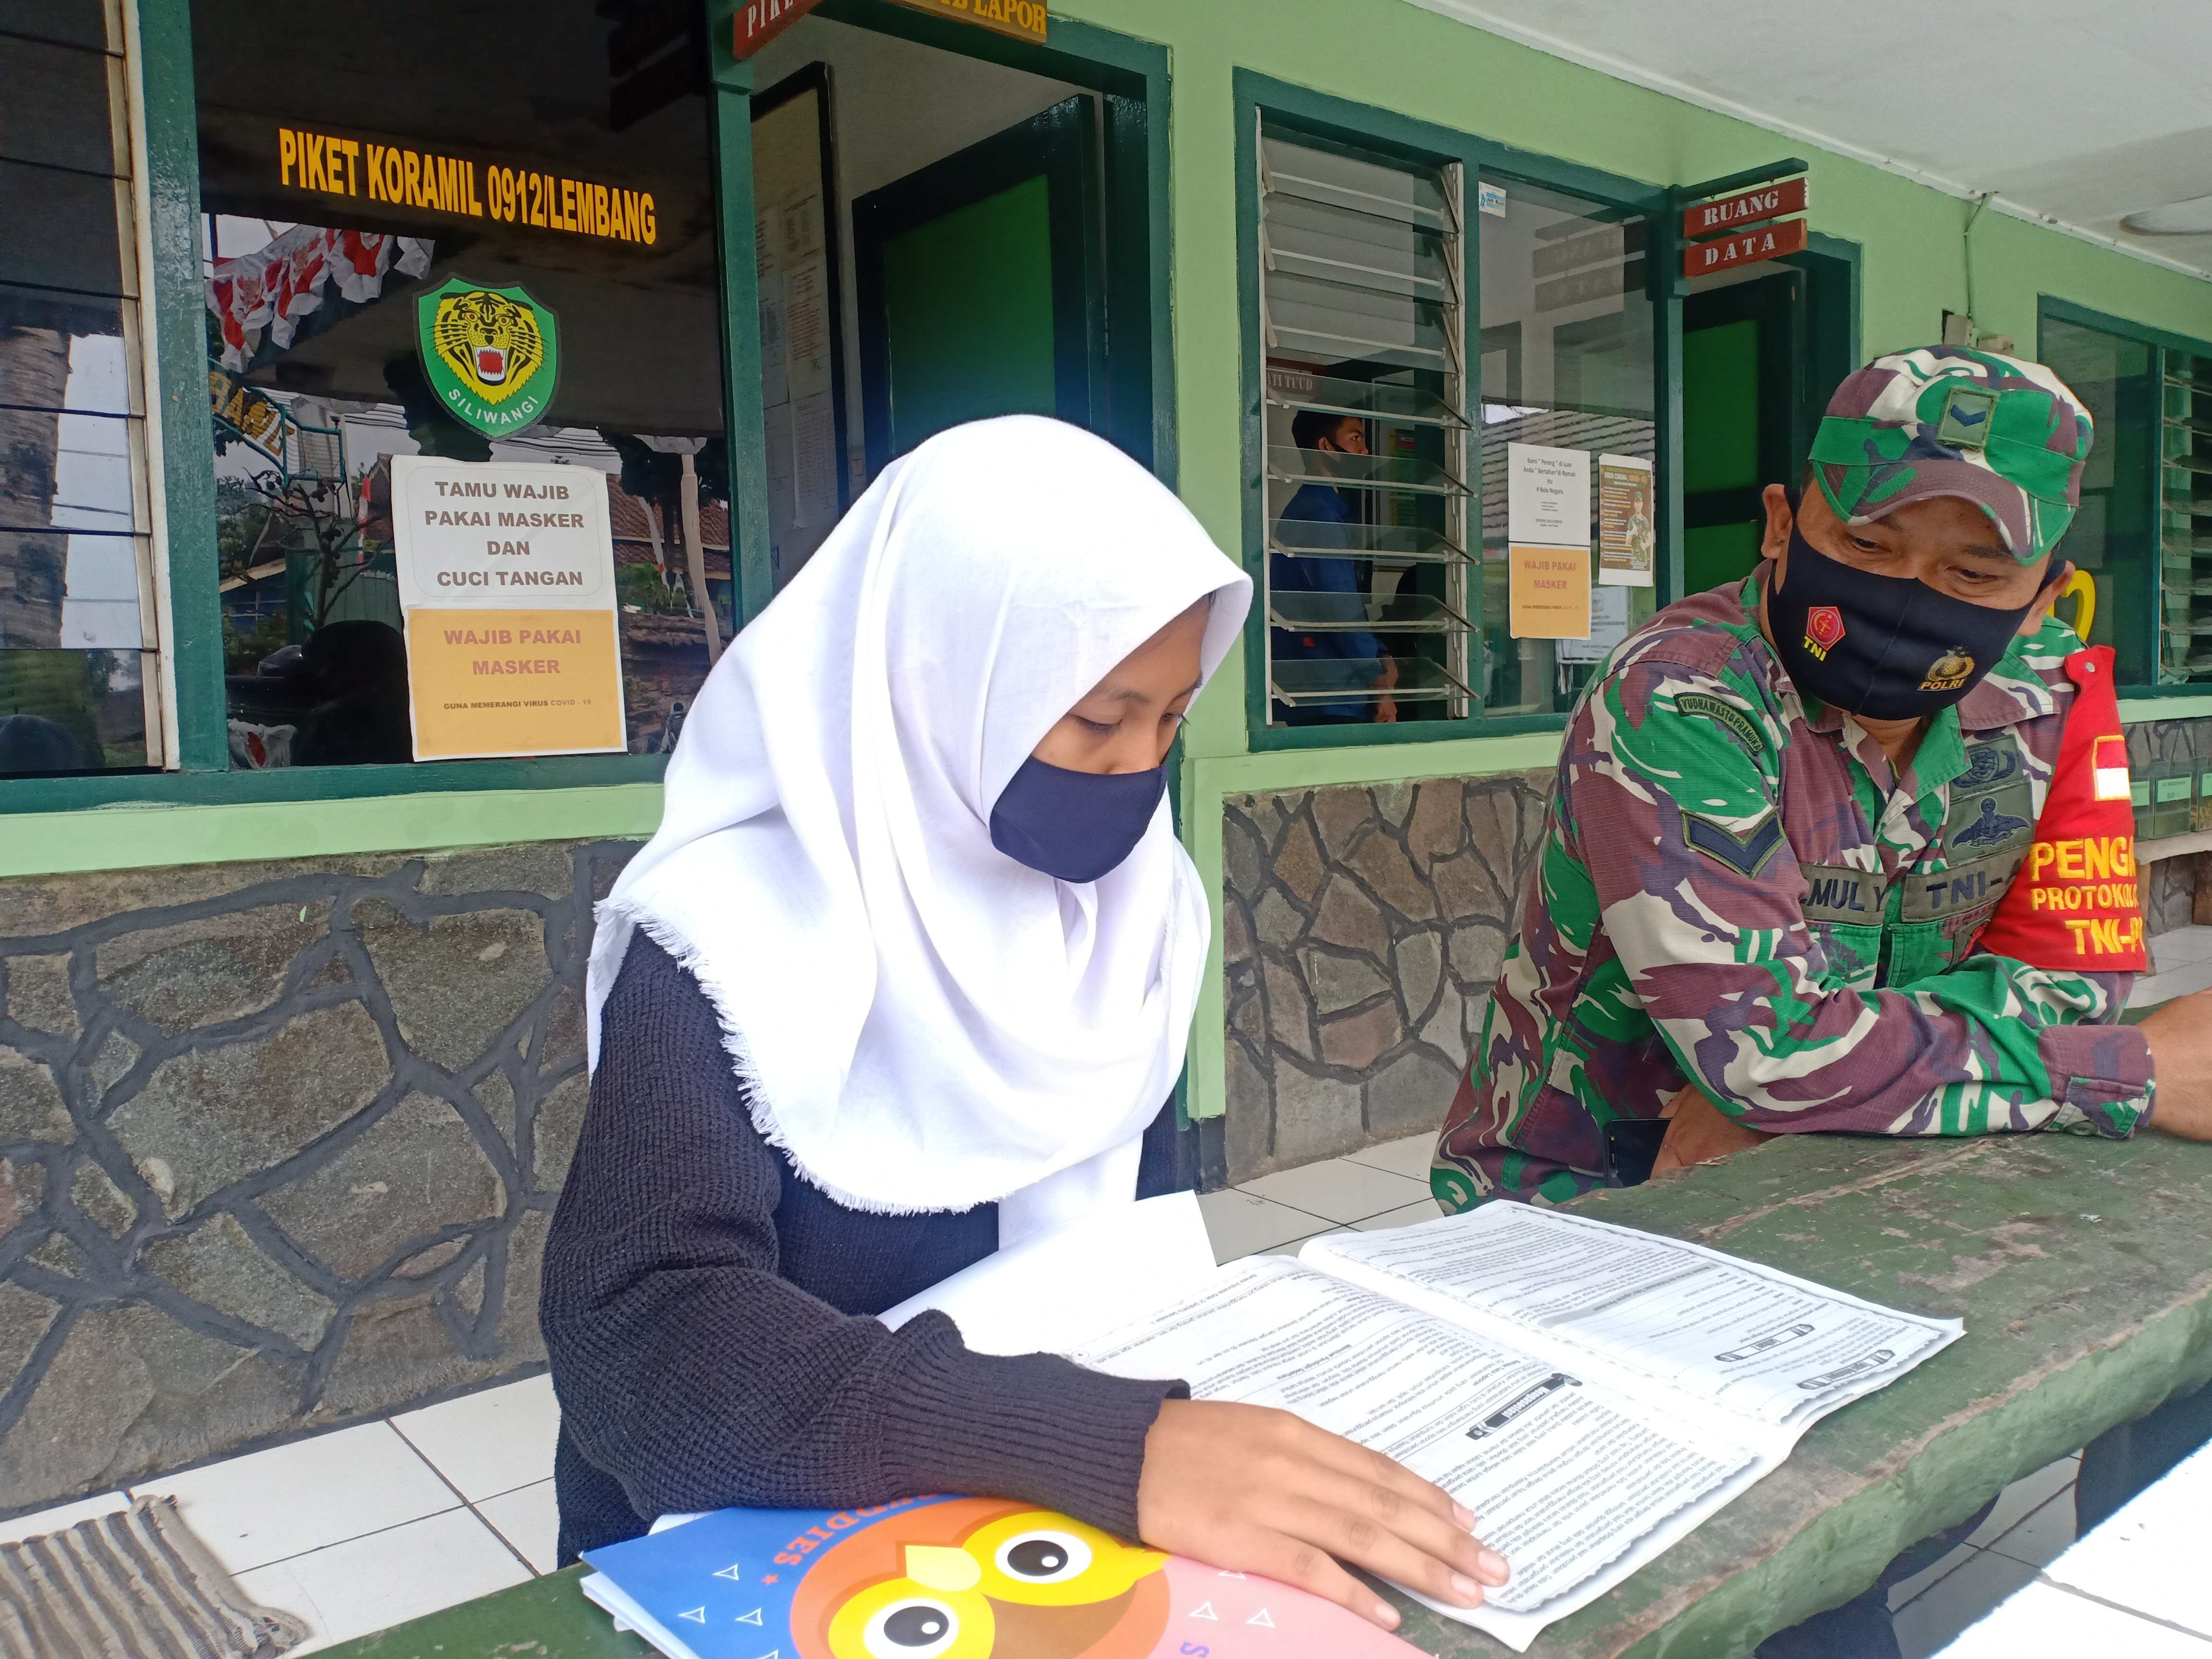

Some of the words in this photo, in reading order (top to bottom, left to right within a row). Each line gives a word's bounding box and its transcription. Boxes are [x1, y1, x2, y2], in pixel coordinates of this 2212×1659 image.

[279, 128, 359, 196] PIKET
[366, 144, 481, 216] KORAMIL
[487, 165, 656, 245] 0912/LEMBANG
[1704, 190, 1779, 226] RUANG
[1705, 233, 1776, 265] DATA
[449, 388, 539, 424] SILIWANGI
[1541, 459, 1555, 467] Perang
[435, 481, 497, 498] TAMU
[503, 483, 570, 500] WAJIB
[424, 510, 490, 527] PAKAI
[498, 512, 585, 528] MASKER
[487, 541, 530, 555] DAN
[1524, 560, 1550, 570] WAJIB
[1552, 562, 1576, 571] PAKAI
[437, 572, 489, 587] CUCI
[496, 571, 583, 586] TANGAN
[1534, 579, 1567, 589] MASKER
[444, 630, 512, 645] WAJIB
[519, 629, 581, 644] PAKAI
[1803, 636, 1827, 662] TNI
[472, 660, 561, 675] MASKER
[1920, 677, 1966, 690] POLRI
[1499, 1385, 1551, 1419] Mengasosiasi
